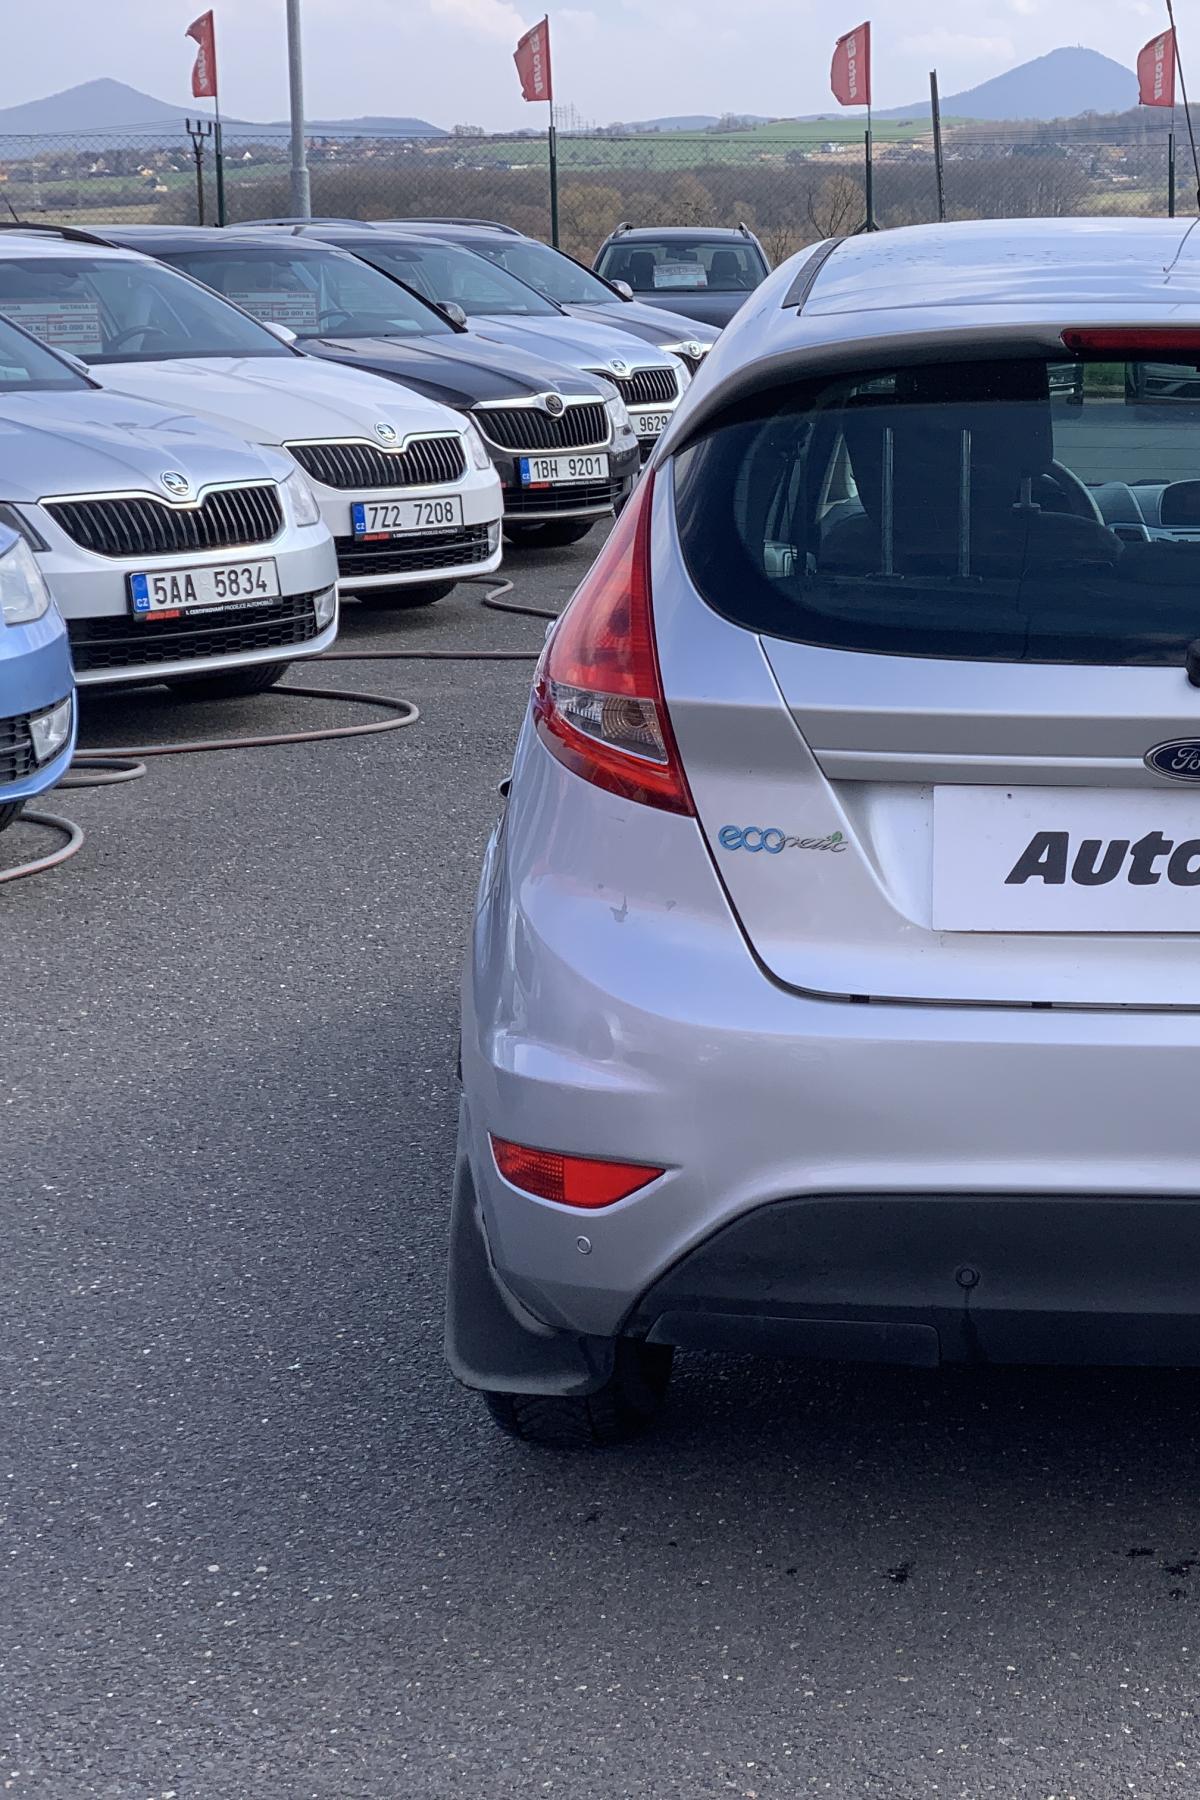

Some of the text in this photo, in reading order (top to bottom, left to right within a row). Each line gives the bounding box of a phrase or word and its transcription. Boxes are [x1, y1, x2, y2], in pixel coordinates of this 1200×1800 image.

[533, 459, 559, 479] 1BH
[568, 457, 602, 476] 9201
[356, 501, 454, 530] CZ 7Z2 7208
[136, 566, 267, 608] CZ 5AA 5834
